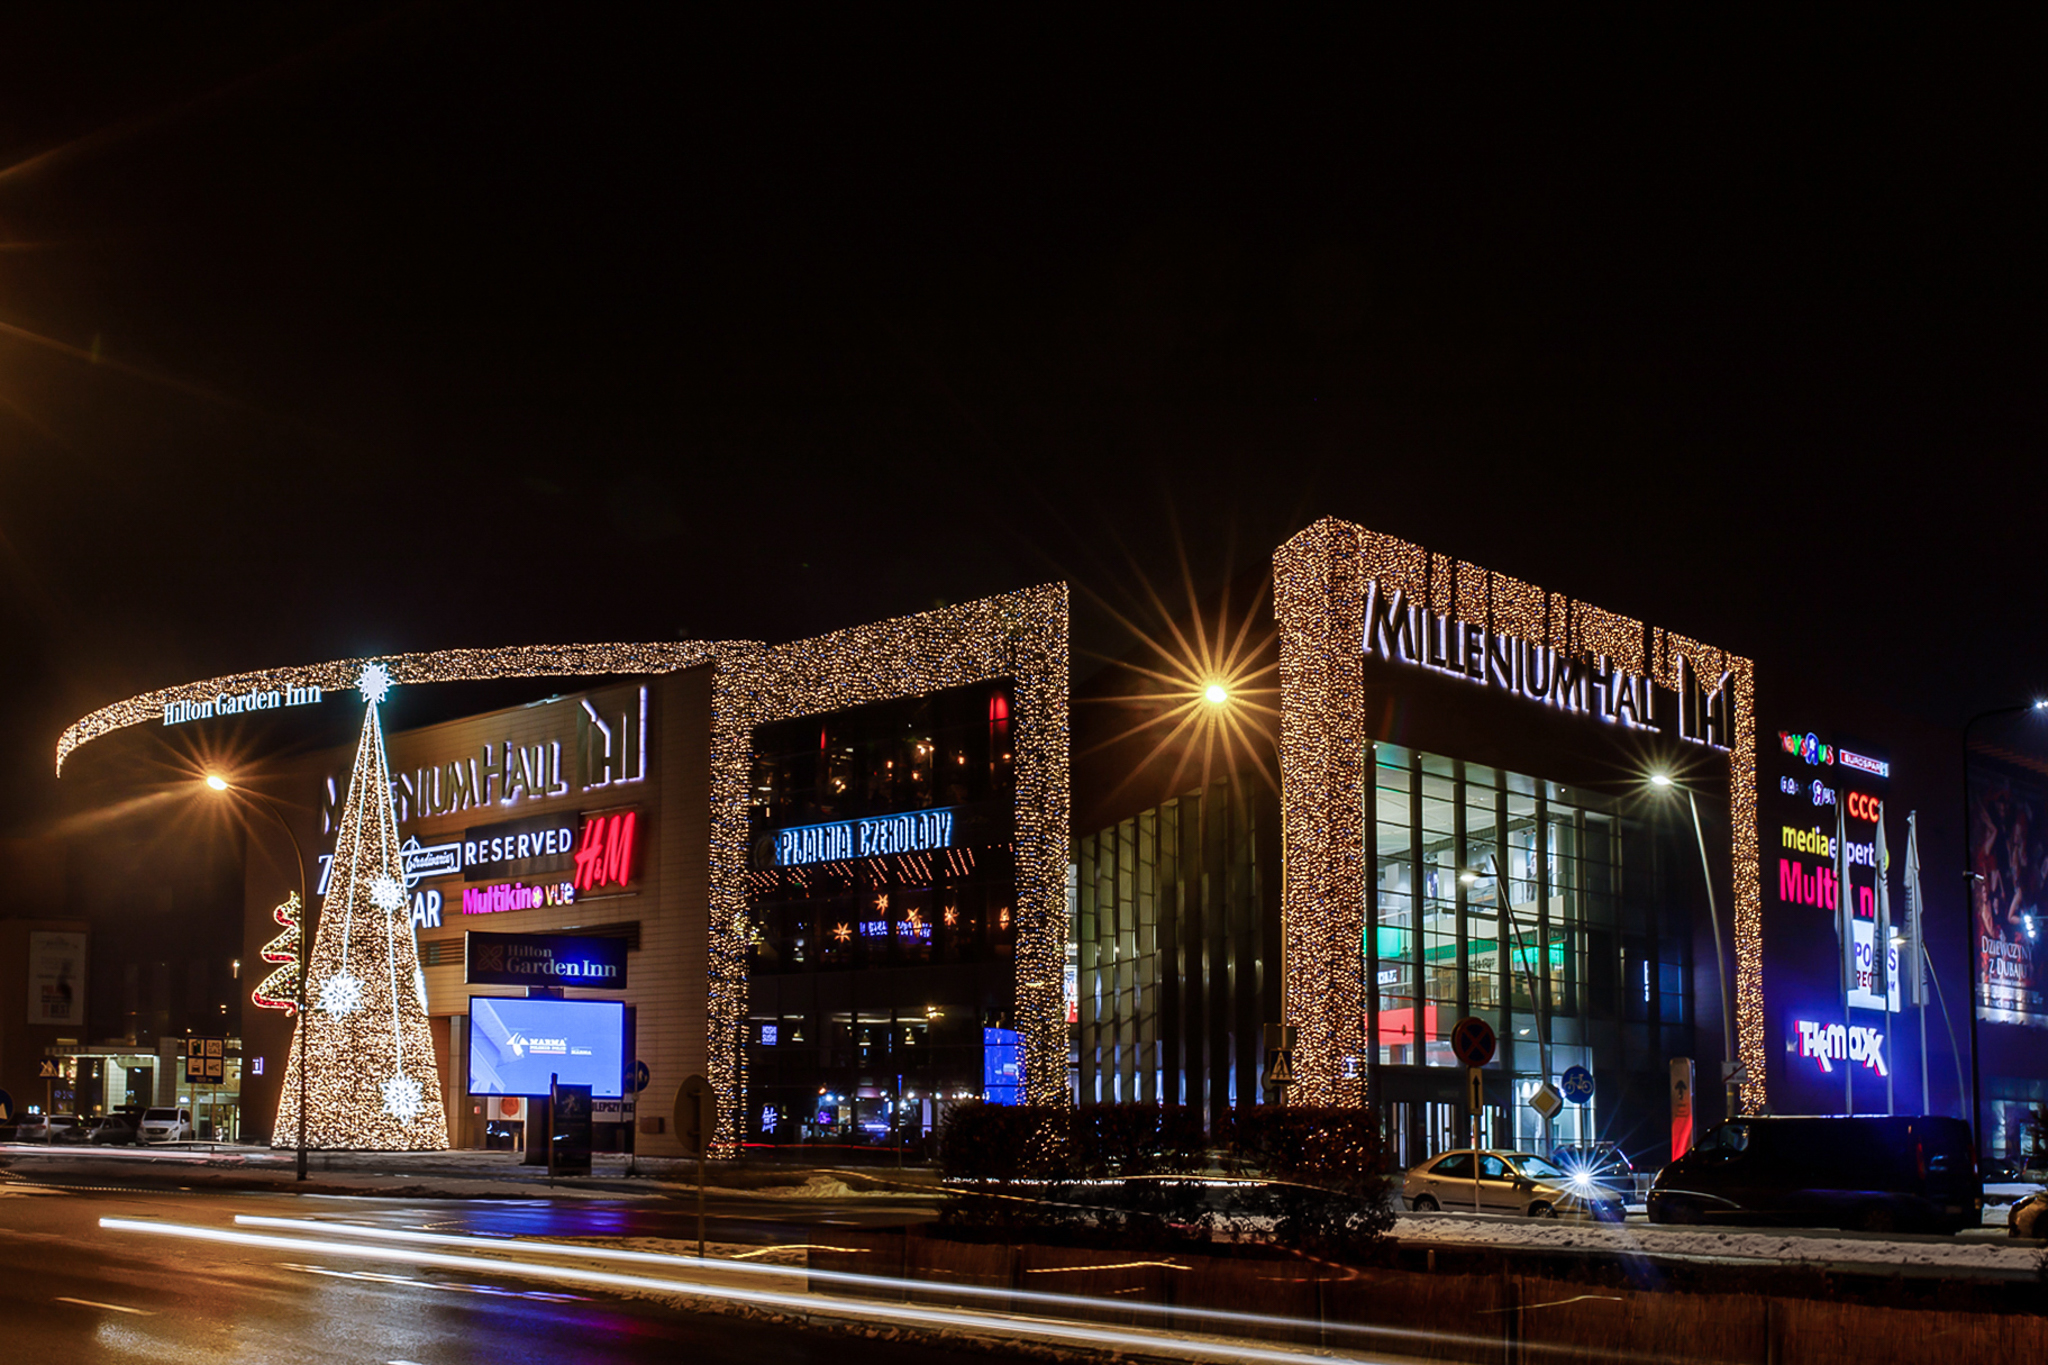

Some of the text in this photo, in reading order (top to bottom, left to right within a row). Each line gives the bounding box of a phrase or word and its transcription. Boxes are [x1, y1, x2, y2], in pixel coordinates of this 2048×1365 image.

[163, 682, 323, 727] Hilton Garden Inn
[1848, 791, 1880, 823] CCC
[465, 828, 572, 866] RESERVED
[574, 811, 636, 892] H&M
[860, 811, 953, 857] CZEKOLADY
[463, 881, 544, 915] Multikino
[506, 957, 618, 977] Garden Inn
[508, 944, 553, 958] Hilton
